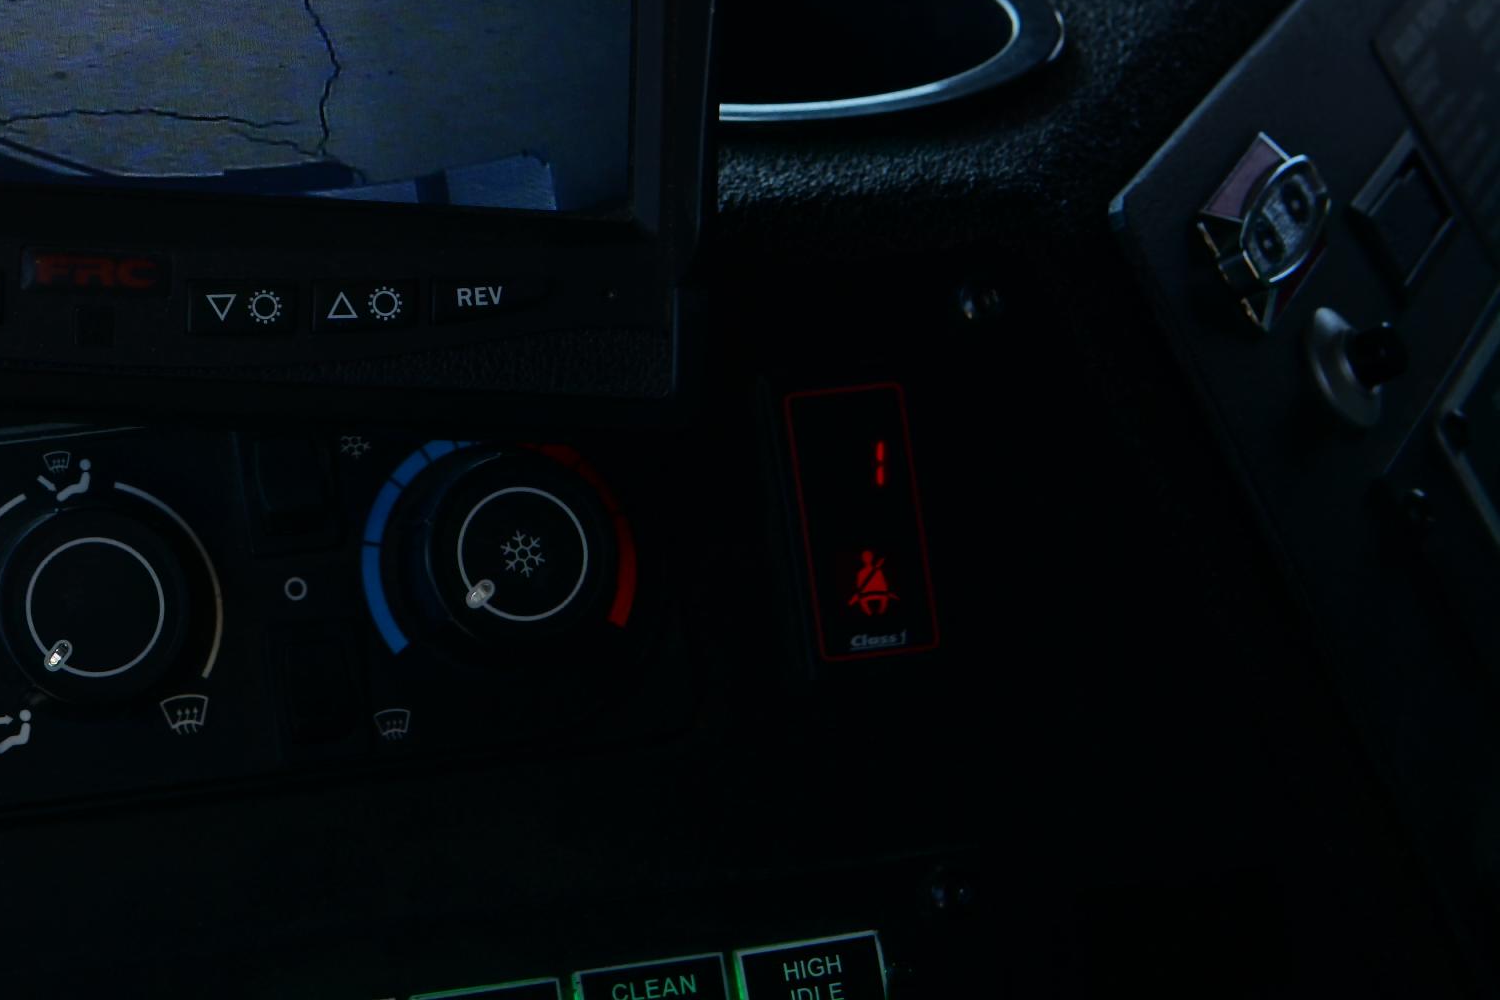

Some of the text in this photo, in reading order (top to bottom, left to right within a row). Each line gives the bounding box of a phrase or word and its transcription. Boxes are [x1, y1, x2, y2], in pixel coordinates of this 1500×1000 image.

[456, 285, 503, 307] REV
[782, 954, 843, 982] HIGH
[610, 973, 698, 1000] CLEAN
